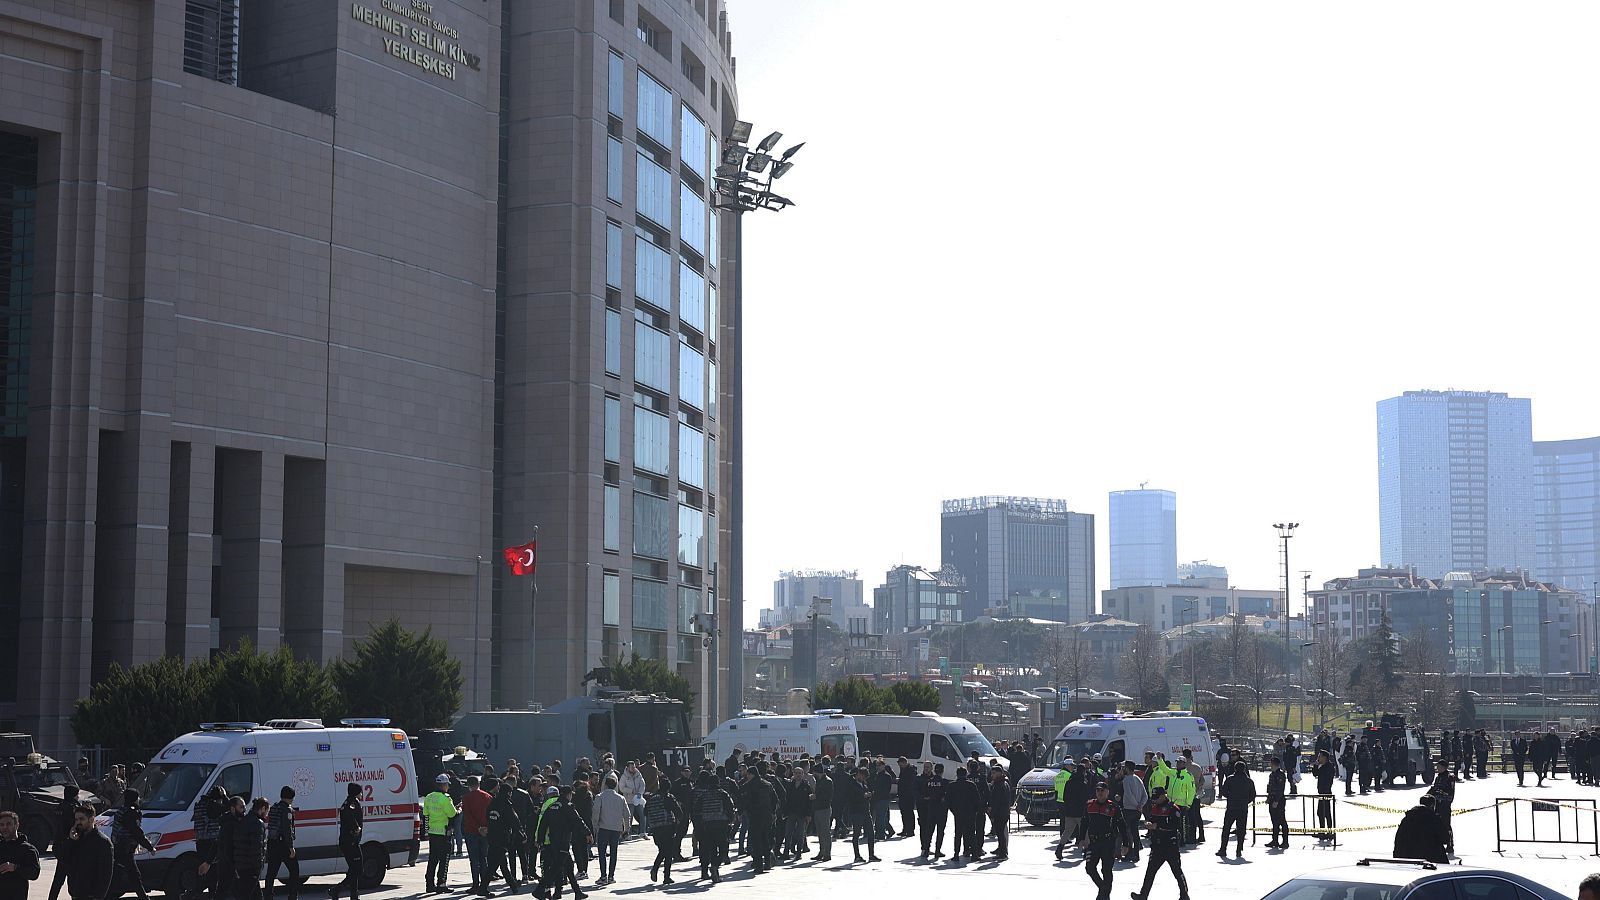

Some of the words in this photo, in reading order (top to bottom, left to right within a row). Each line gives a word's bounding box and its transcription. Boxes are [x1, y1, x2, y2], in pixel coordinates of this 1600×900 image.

[352, 3, 408, 38] MEHMET
[942, 496, 987, 512] KOLAN
[1007, 496, 1067, 512] KOLAN
[471, 734, 480, 750] T
[484, 734, 498, 750] 31
[662, 750, 674, 766] T
[676, 749, 689, 767] 31
[335, 770, 355, 783] SAĞLIK
